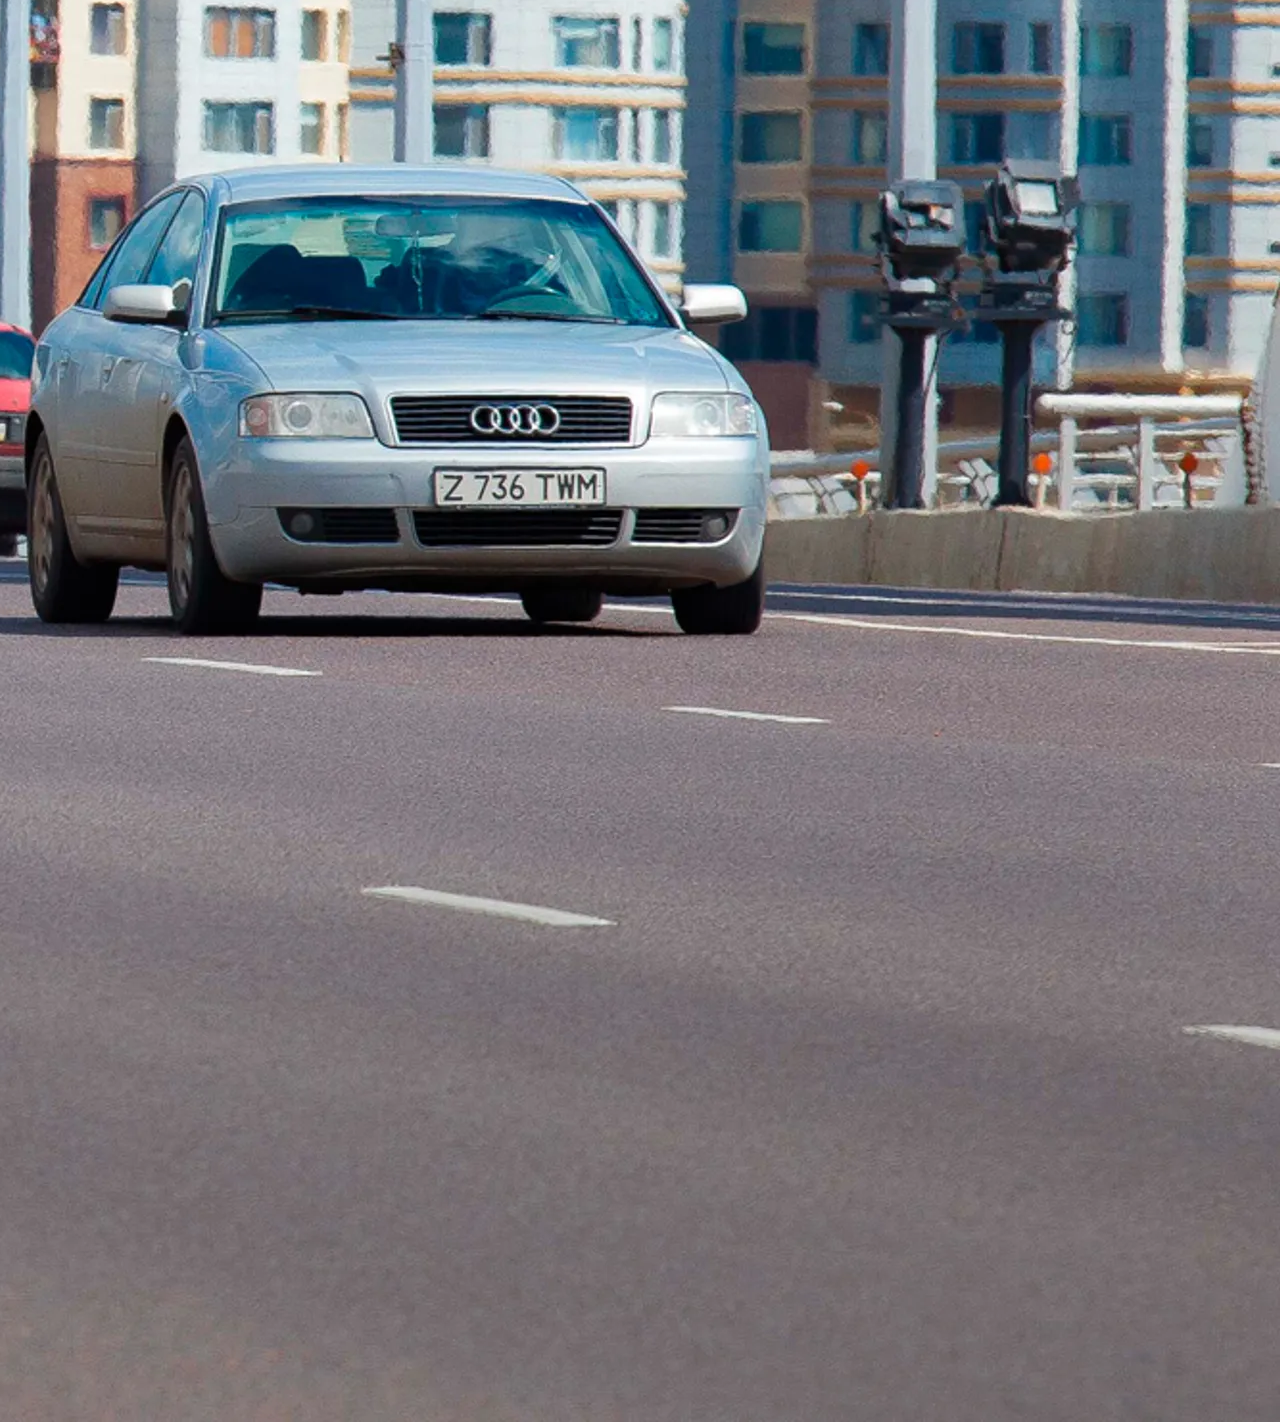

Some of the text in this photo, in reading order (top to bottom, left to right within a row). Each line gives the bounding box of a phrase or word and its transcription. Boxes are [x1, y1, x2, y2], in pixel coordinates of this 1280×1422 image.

[443, 473, 597, 501] Z 736 TWM
